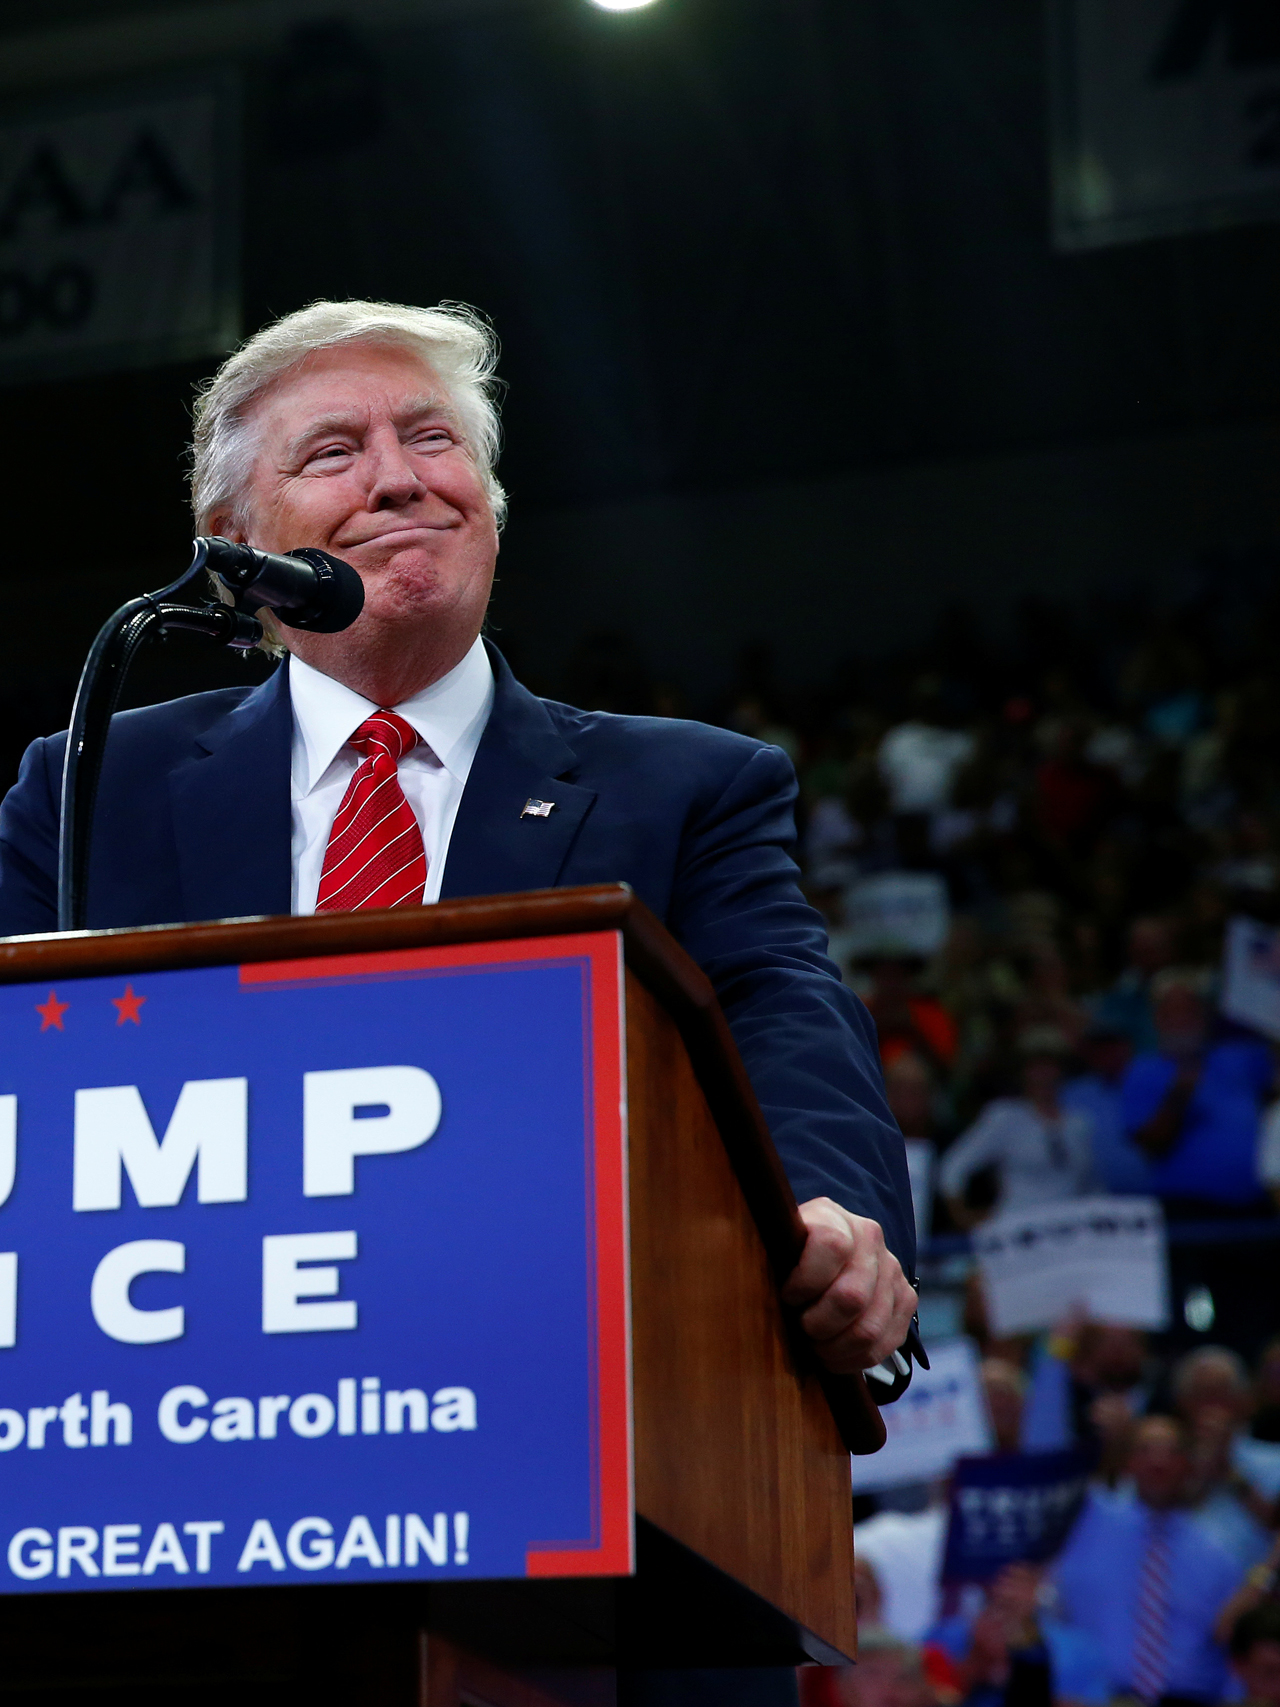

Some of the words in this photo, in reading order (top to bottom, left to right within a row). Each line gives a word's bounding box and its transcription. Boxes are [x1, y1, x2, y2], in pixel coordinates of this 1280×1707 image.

[157, 1376, 478, 1444] Carolina
[7, 1520, 225, 1580] GREAT
[236, 1511, 470, 1572] AGAIN!
